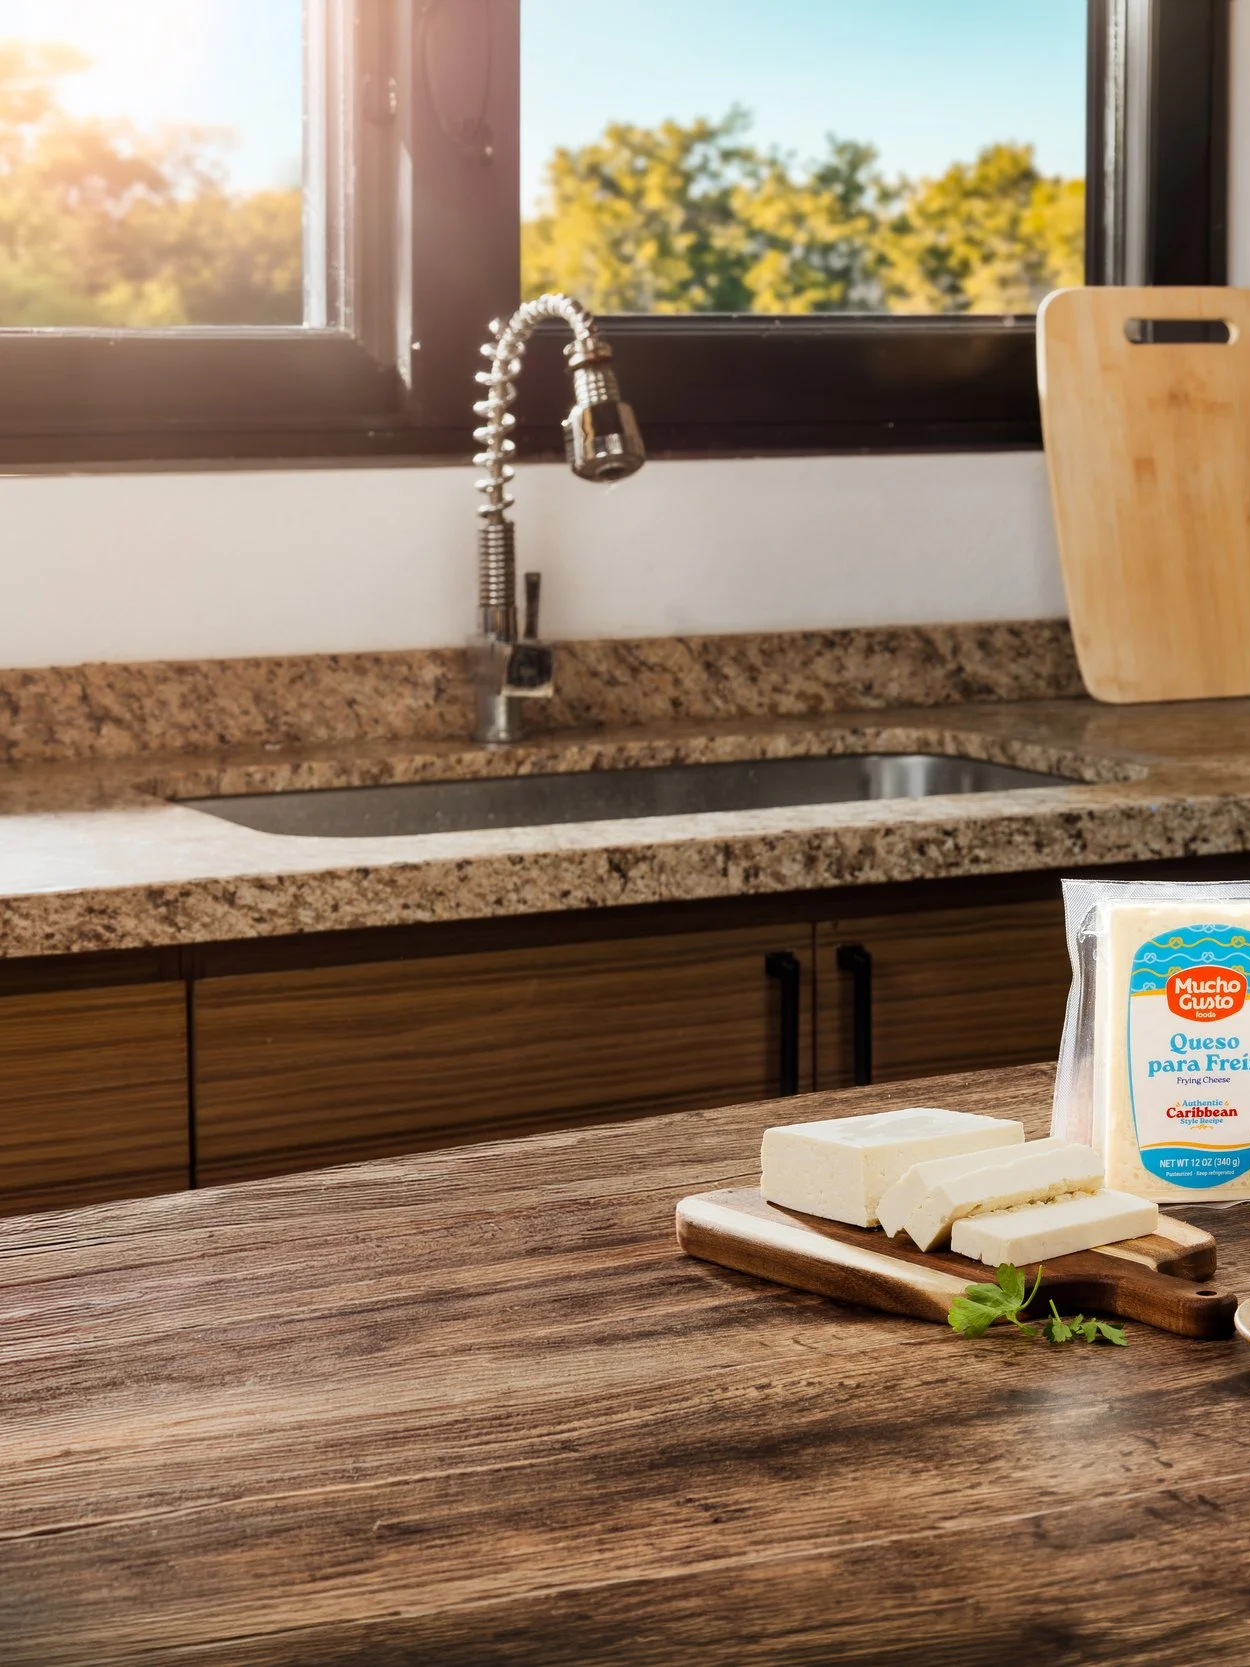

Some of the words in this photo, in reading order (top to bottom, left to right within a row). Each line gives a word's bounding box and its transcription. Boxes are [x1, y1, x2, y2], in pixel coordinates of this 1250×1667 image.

[1175, 976, 1241, 994] Mucho
[1179, 994, 1234, 1010] Gusto
[1170, 1033, 1240, 1054] Queso
[1148, 1060, 1200, 1077] para
[1177, 1077, 1201, 1085] Frying
[1203, 1076, 1231, 1084] Cheese
[1166, 1107, 1238, 1118] Caribbean
[1160, 1159, 1176, 1168] NET
[1177, 1158, 1189, 1167] WT
[1191, 1158, 1200, 1167] 12
[1202, 1158, 1212, 1167] OZ
[1214, 1157, 1231, 1168] (340
[1232, 1157, 1240, 1167] g)
